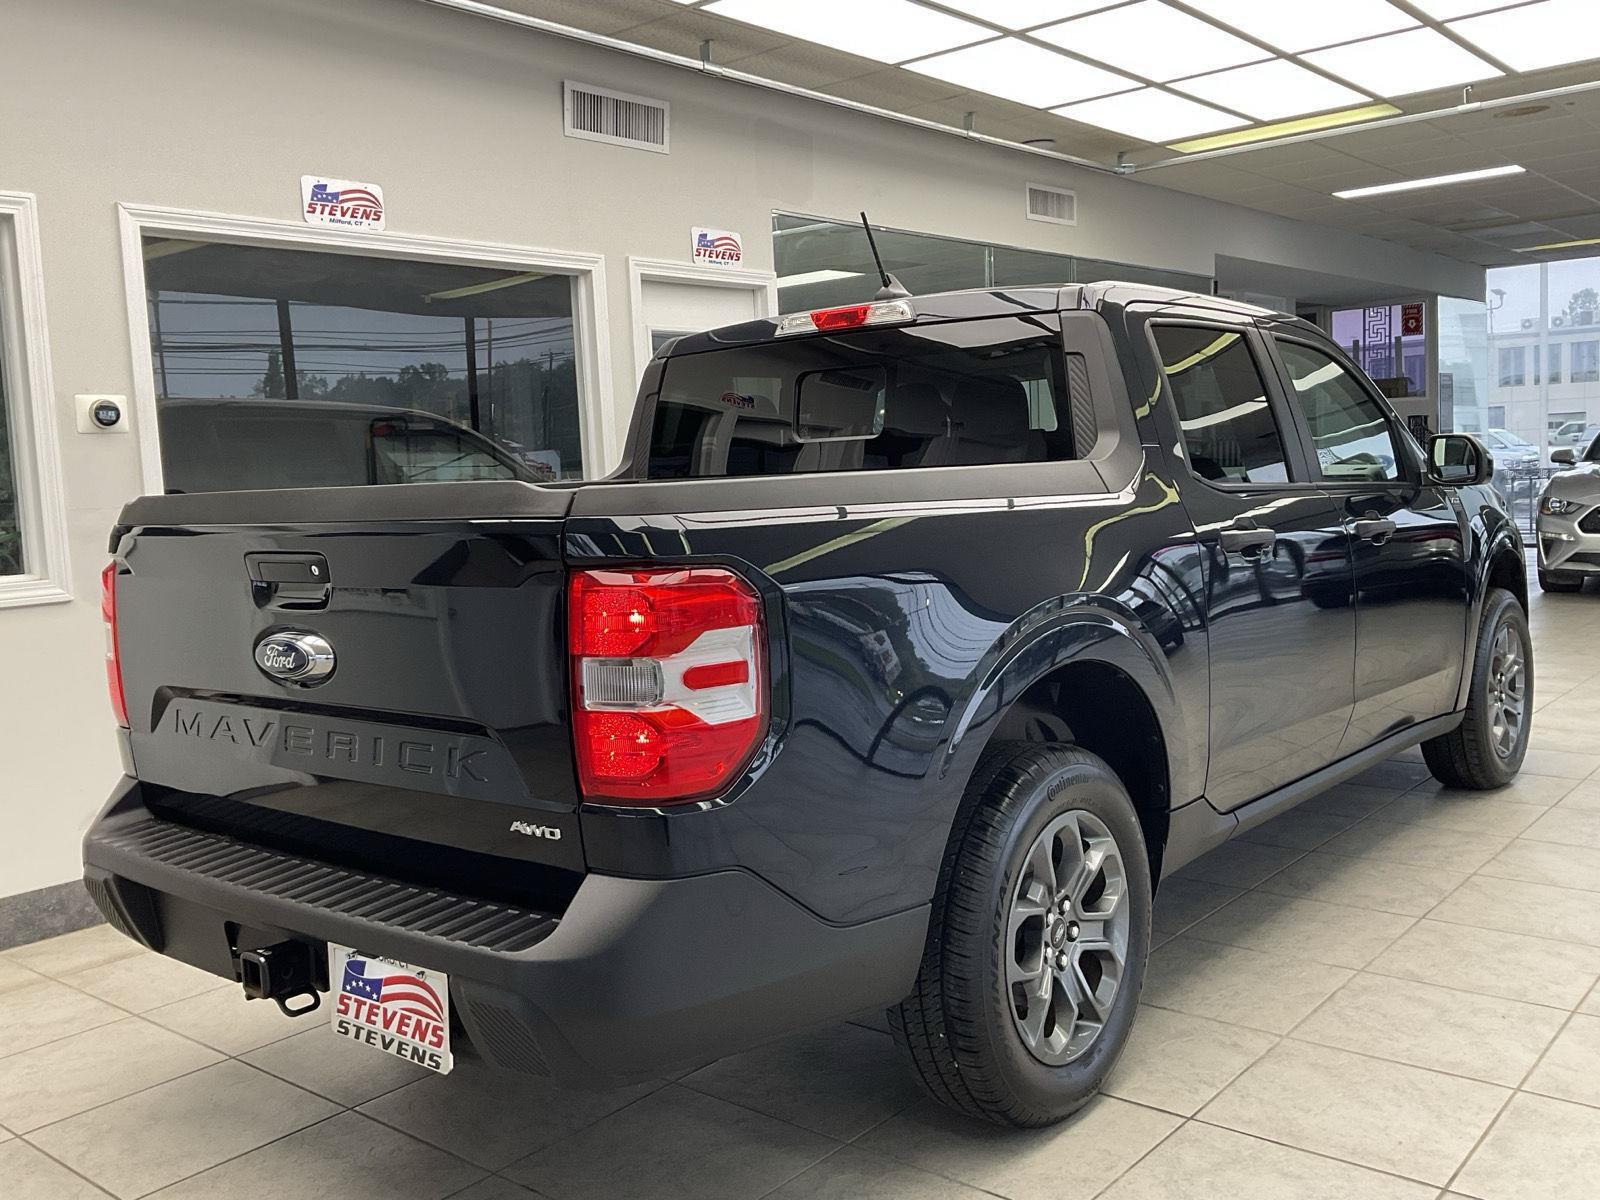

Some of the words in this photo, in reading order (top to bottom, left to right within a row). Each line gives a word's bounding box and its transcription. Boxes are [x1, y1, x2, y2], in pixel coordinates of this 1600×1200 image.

[306, 202, 383, 222] STEVENS
[695, 248, 741, 262] STEVENS
[264, 644, 296, 669] Ford
[175, 708, 489, 783] MAVERICK
[510, 821, 562, 840] AWD
[336, 993, 444, 1049] STEVENS
[336, 1020, 443, 1070] STEVENS
